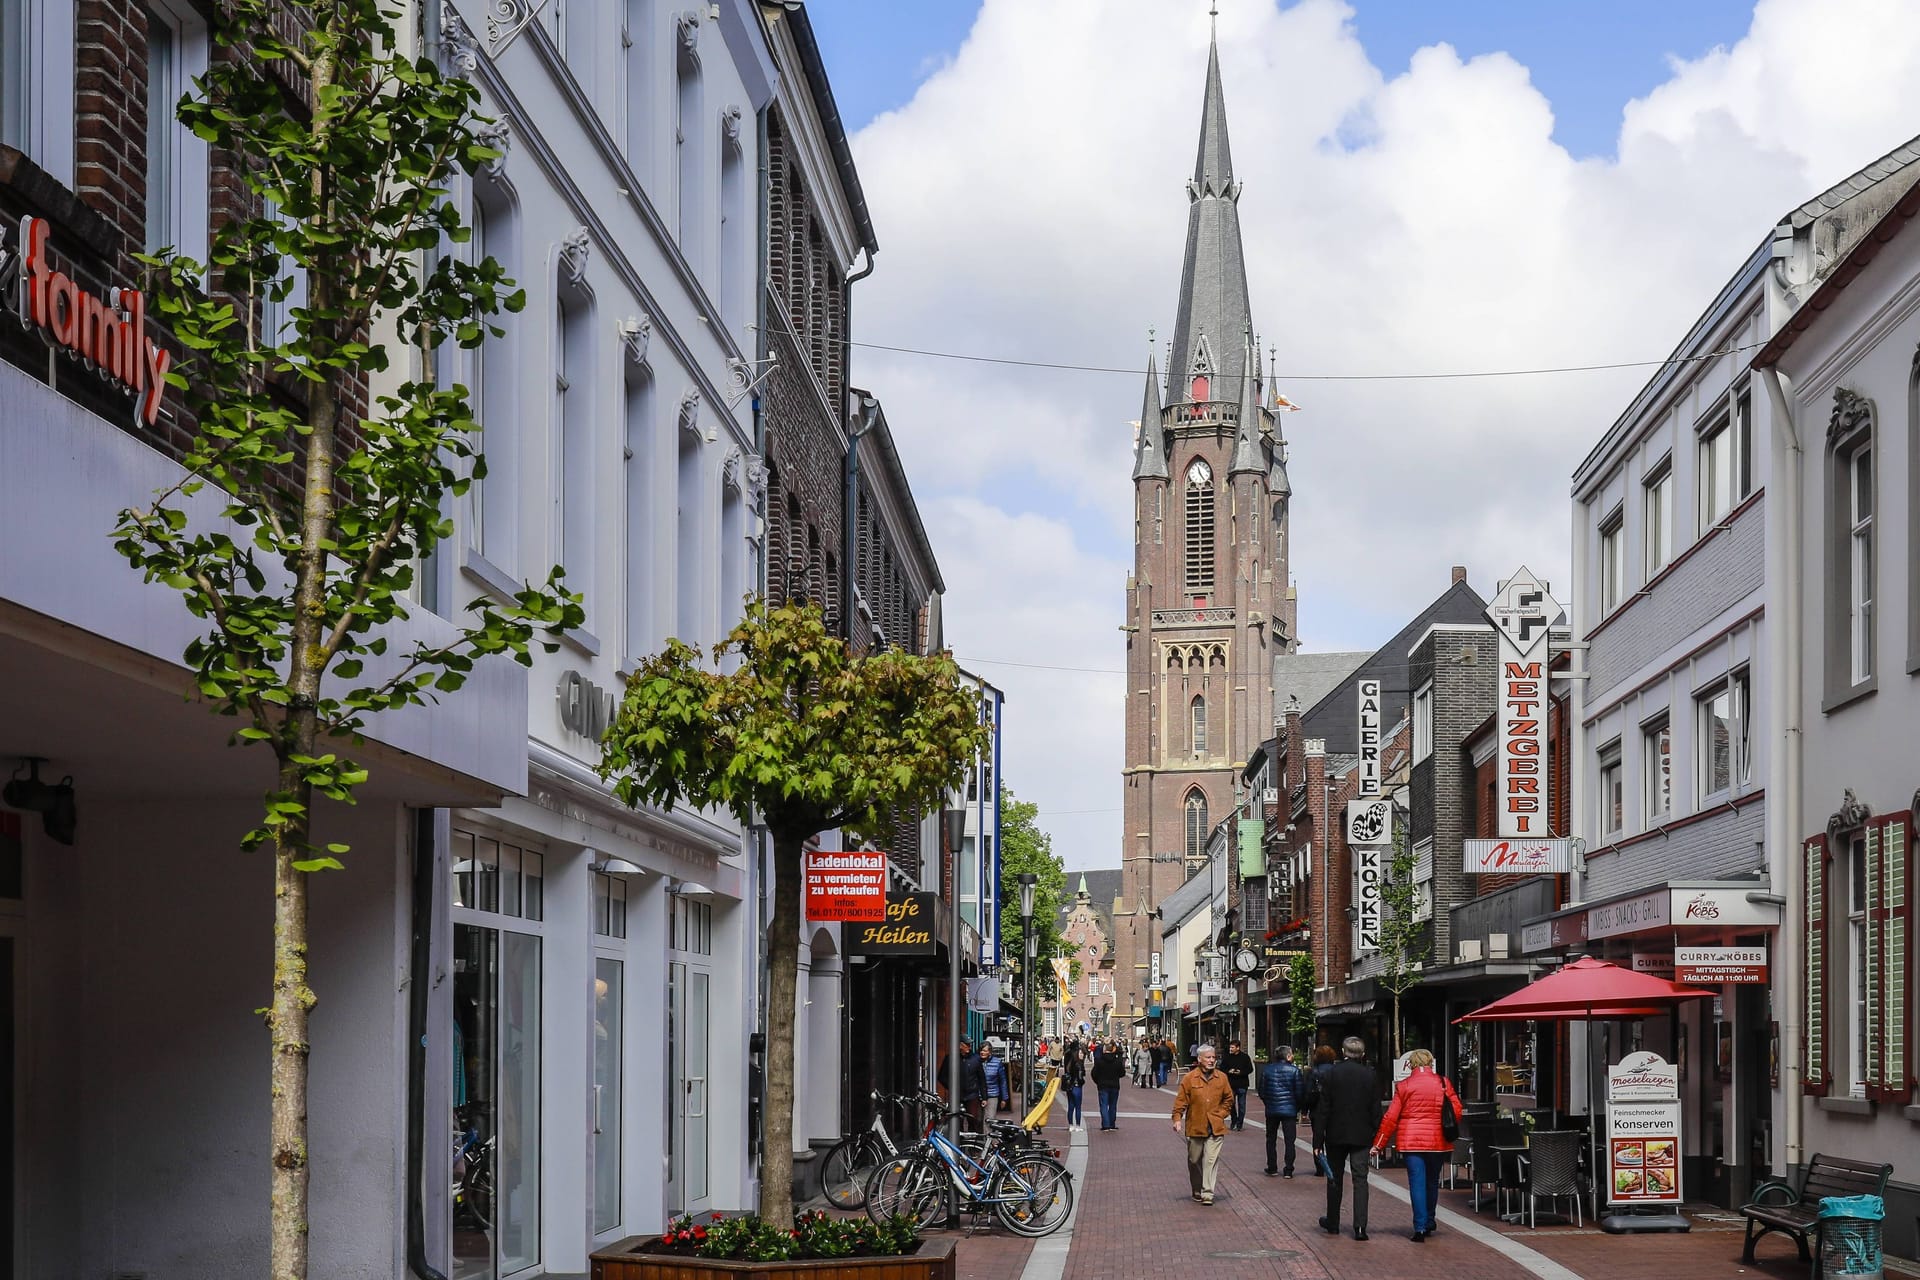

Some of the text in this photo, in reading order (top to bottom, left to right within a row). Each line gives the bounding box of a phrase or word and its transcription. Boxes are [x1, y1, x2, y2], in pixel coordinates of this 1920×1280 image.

[26, 216, 171, 427] family
[1361, 683, 1378, 793] GALERIE
[1504, 662, 1542, 832] METZGEREI
[808, 854, 883, 868] Ladenlokal
[808, 875, 821, 884] zu
[811, 885, 879, 895] zu verkaufen
[1361, 853, 1380, 948] KOCKEN
[885, 897, 920, 921] afe
[1593, 908, 1611, 930] IMBISS
[1615, 902, 1638, 928] SNACKS
[1642, 898, 1660, 920] GRILL
[861, 925, 930, 944] Heilen
[1637, 959, 1672, 967] CURRY
[1680, 951, 1762, 961] CURRY KÖBES
[1683, 973, 1713, 982] TÄGLICH
[1613, 1109, 1666, 1117] Feinschmecker
[1614, 1119, 1674, 1129] Konserven
